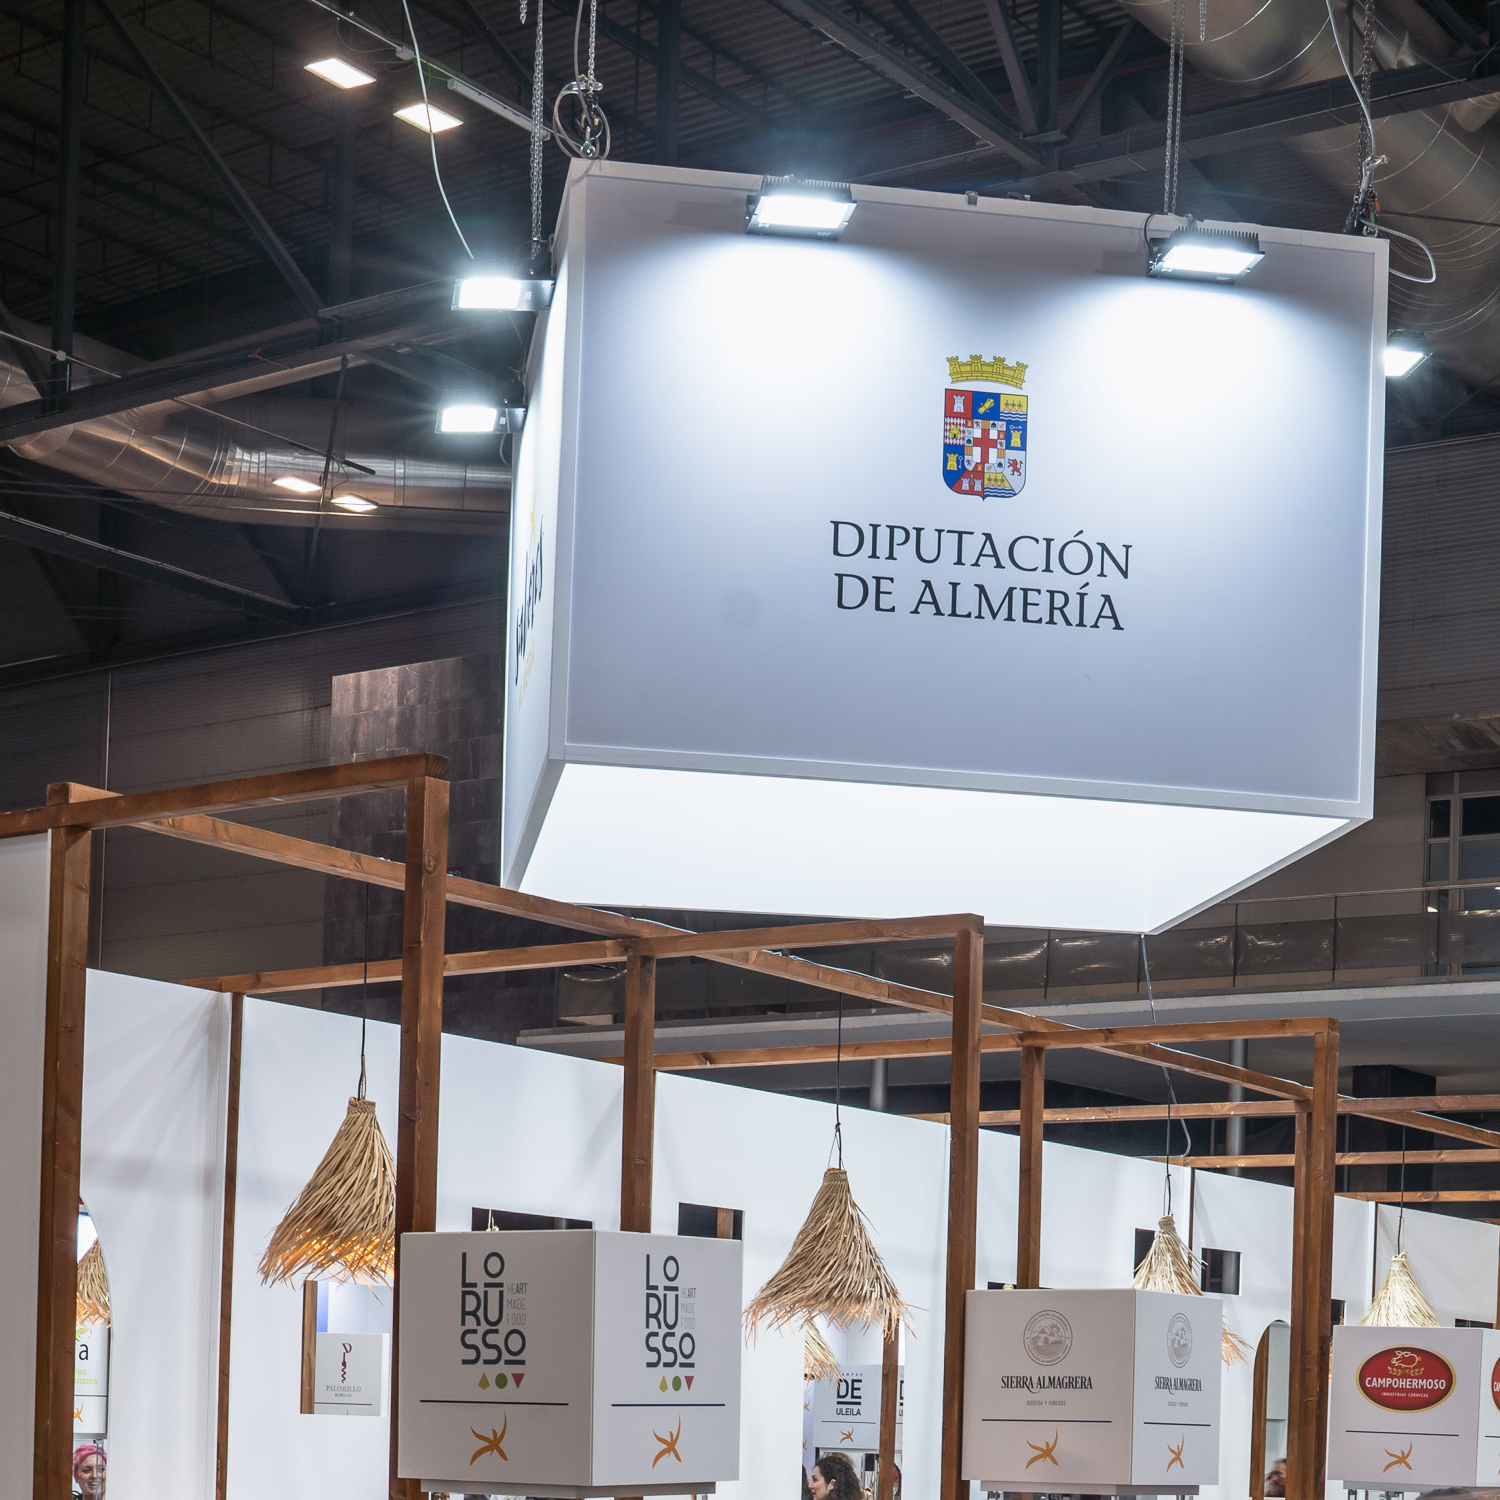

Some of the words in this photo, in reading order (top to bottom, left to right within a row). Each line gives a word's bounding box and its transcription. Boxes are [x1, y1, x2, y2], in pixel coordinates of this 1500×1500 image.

[830, 520, 1133, 579] DIPUTACIÓN
[834, 572, 896, 613] DE
[909, 580, 1124, 631] ALMERÍA
[507, 1283, 529, 1295] HEART
[507, 1298, 526, 1310] MADE
[507, 1313, 527, 1326] FOOD
[836, 1379, 862, 1400] DE
[1001, 1376, 1037, 1393] SIERRA
[1036, 1376, 1093, 1390] ALMAGRERA
[1155, 1376, 1173, 1394] SIERRA
[1172, 1378, 1202, 1392] ALMAGRERA
[1365, 1377, 1446, 1390] CAMPOHERMOSO
[836, 1408, 862, 1416] ULEILA
